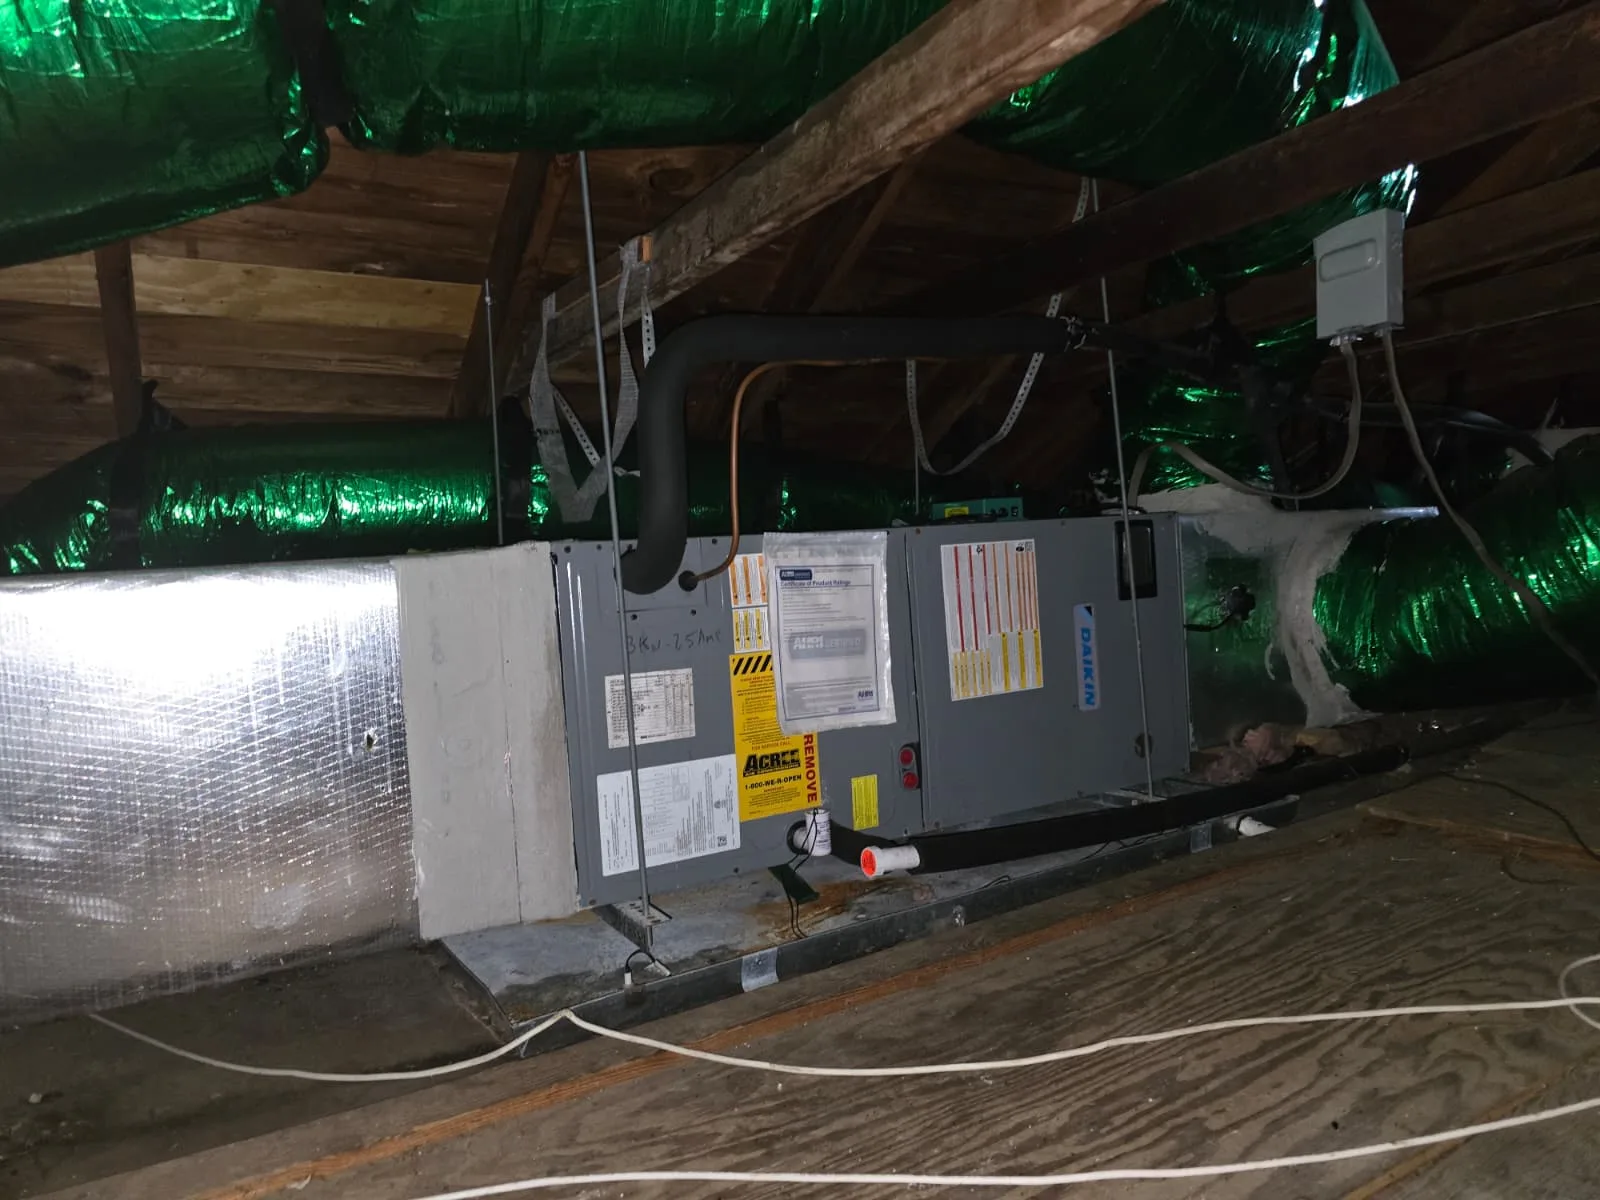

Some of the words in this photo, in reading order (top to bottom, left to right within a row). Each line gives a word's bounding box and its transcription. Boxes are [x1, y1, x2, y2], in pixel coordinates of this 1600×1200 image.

[813, 579, 832, 587] Product
[1081, 627, 1095, 706] DAIKIN
[744, 748, 800, 771] ACREE
[804, 734, 818, 804] REMOVE
